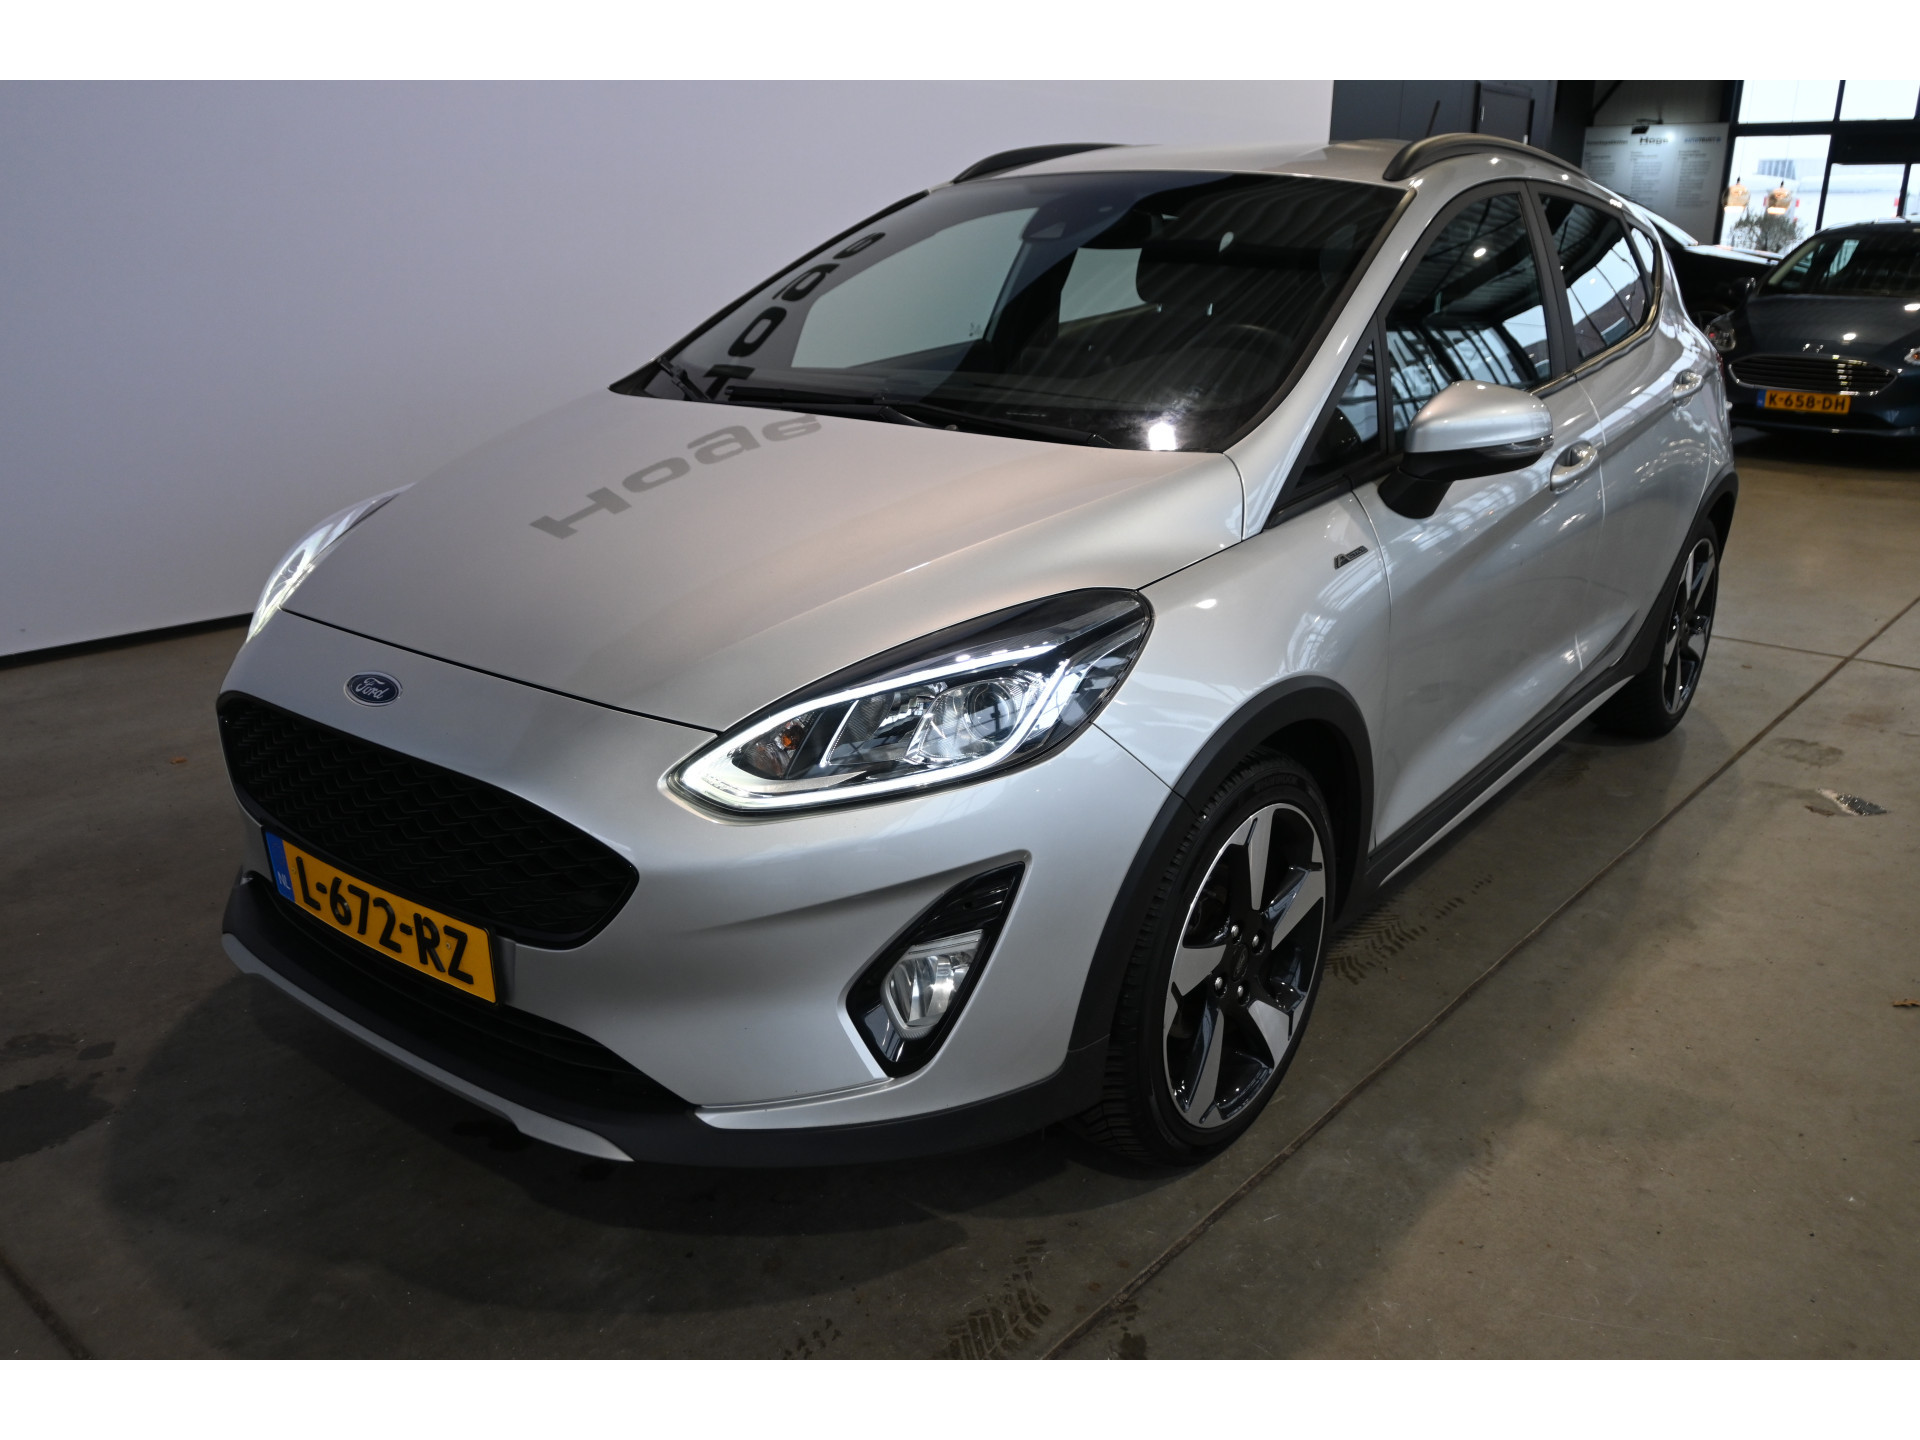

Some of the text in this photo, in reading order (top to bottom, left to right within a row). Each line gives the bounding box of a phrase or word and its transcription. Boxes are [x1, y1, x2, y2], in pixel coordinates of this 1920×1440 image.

[1768, 392, 1846, 411] K-658-DH
[355, 677, 390, 699] Ford
[277, 870, 292, 890] NL
[296, 856, 475, 986] L-672-RZ
